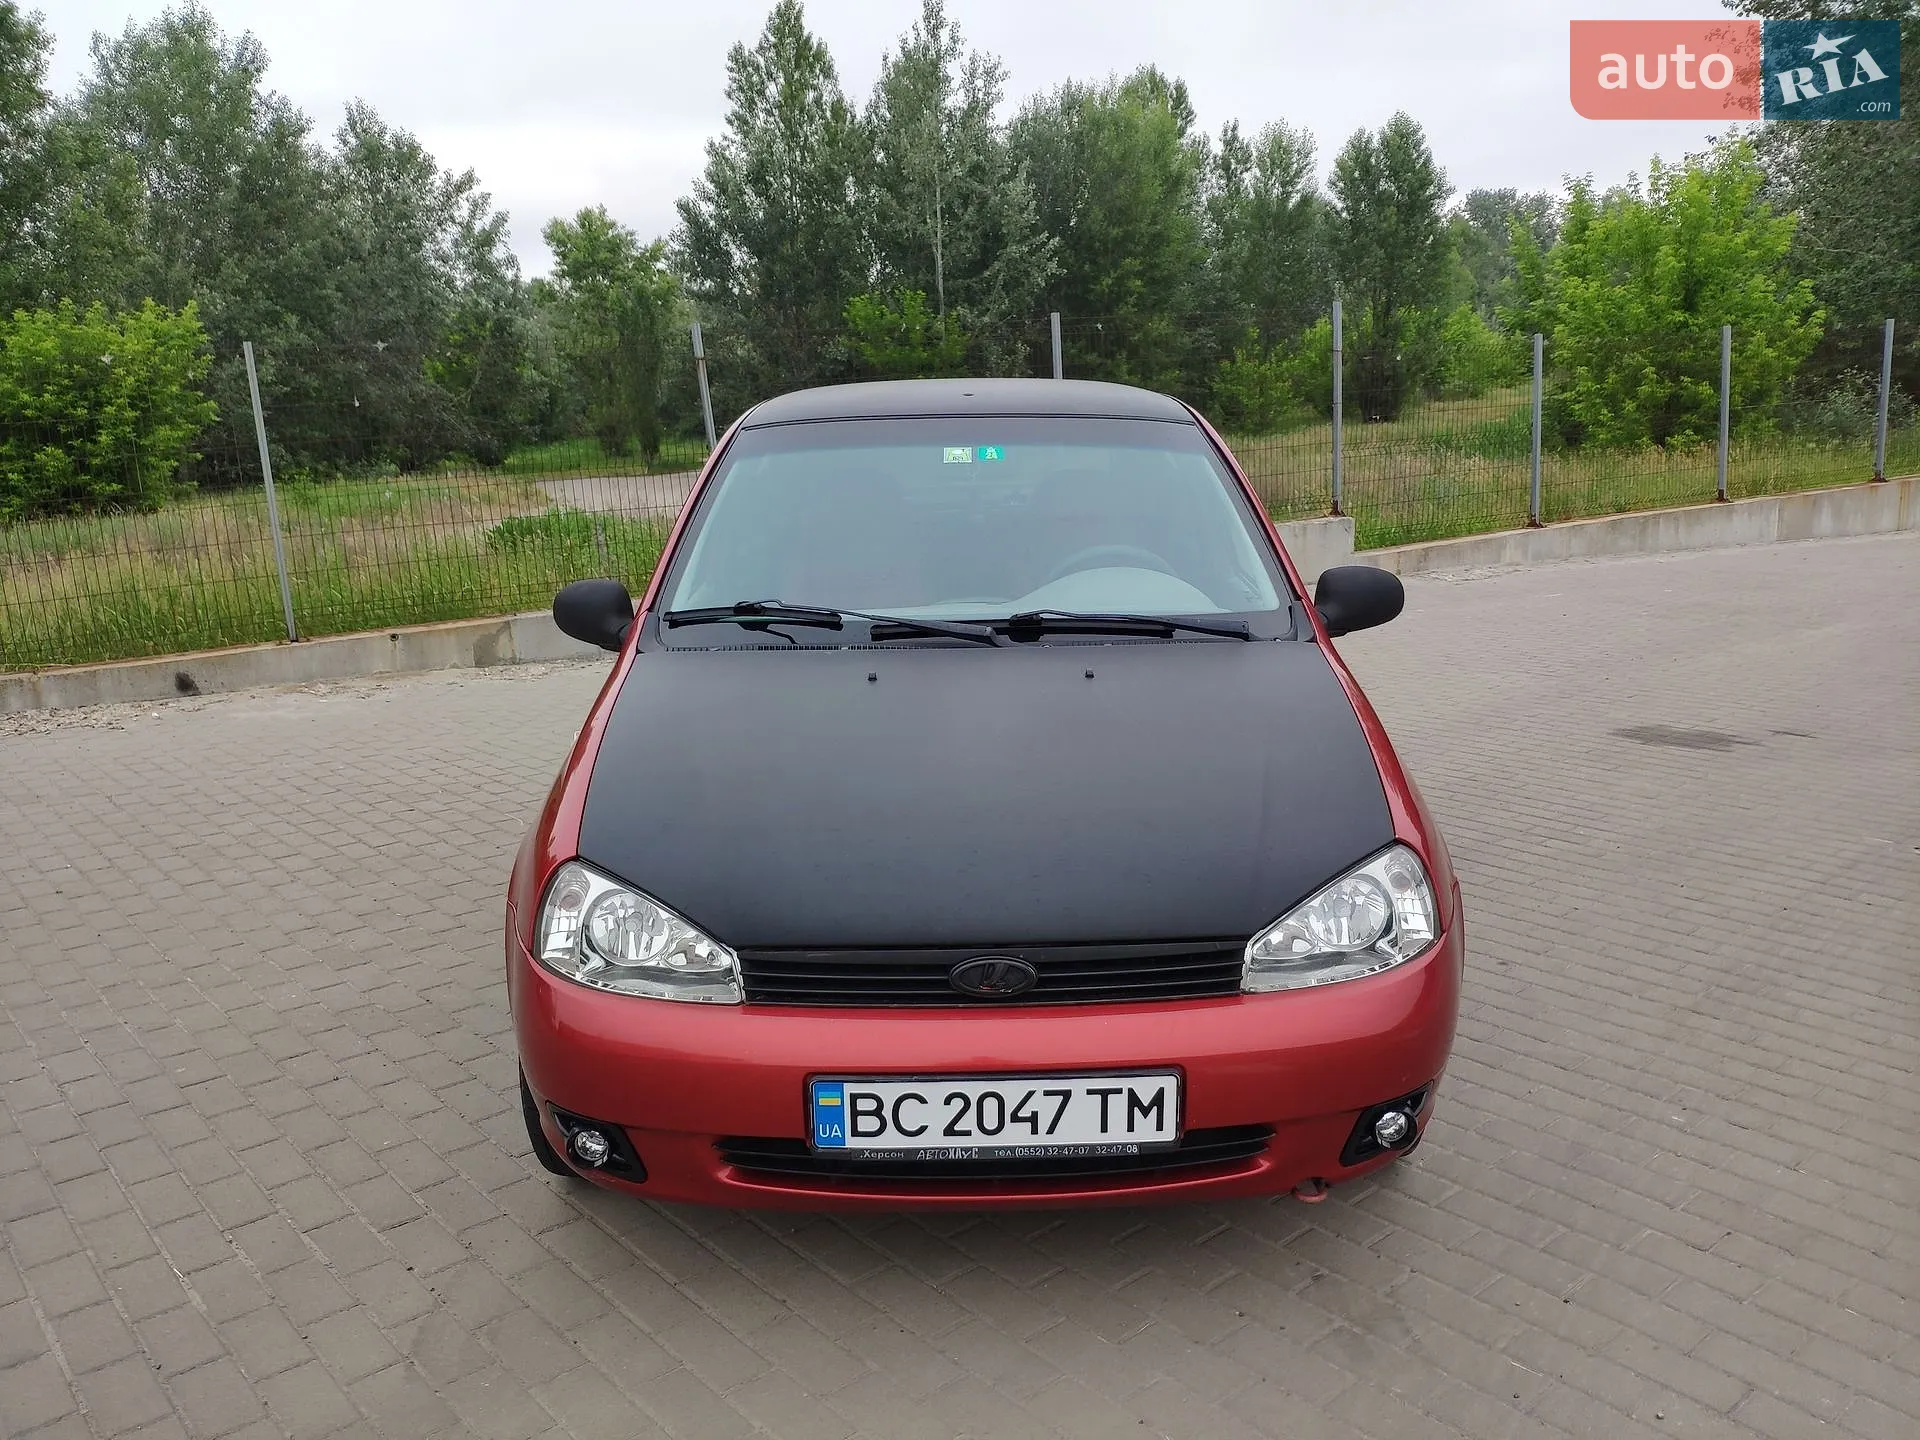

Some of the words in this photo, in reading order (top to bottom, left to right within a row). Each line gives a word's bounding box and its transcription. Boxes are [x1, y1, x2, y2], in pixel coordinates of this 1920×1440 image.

[849, 1092, 929, 1138] BC
[942, 1089, 1072, 1137] 2047
[1086, 1087, 1164, 1134] TM
[819, 1123, 842, 1138] UA
